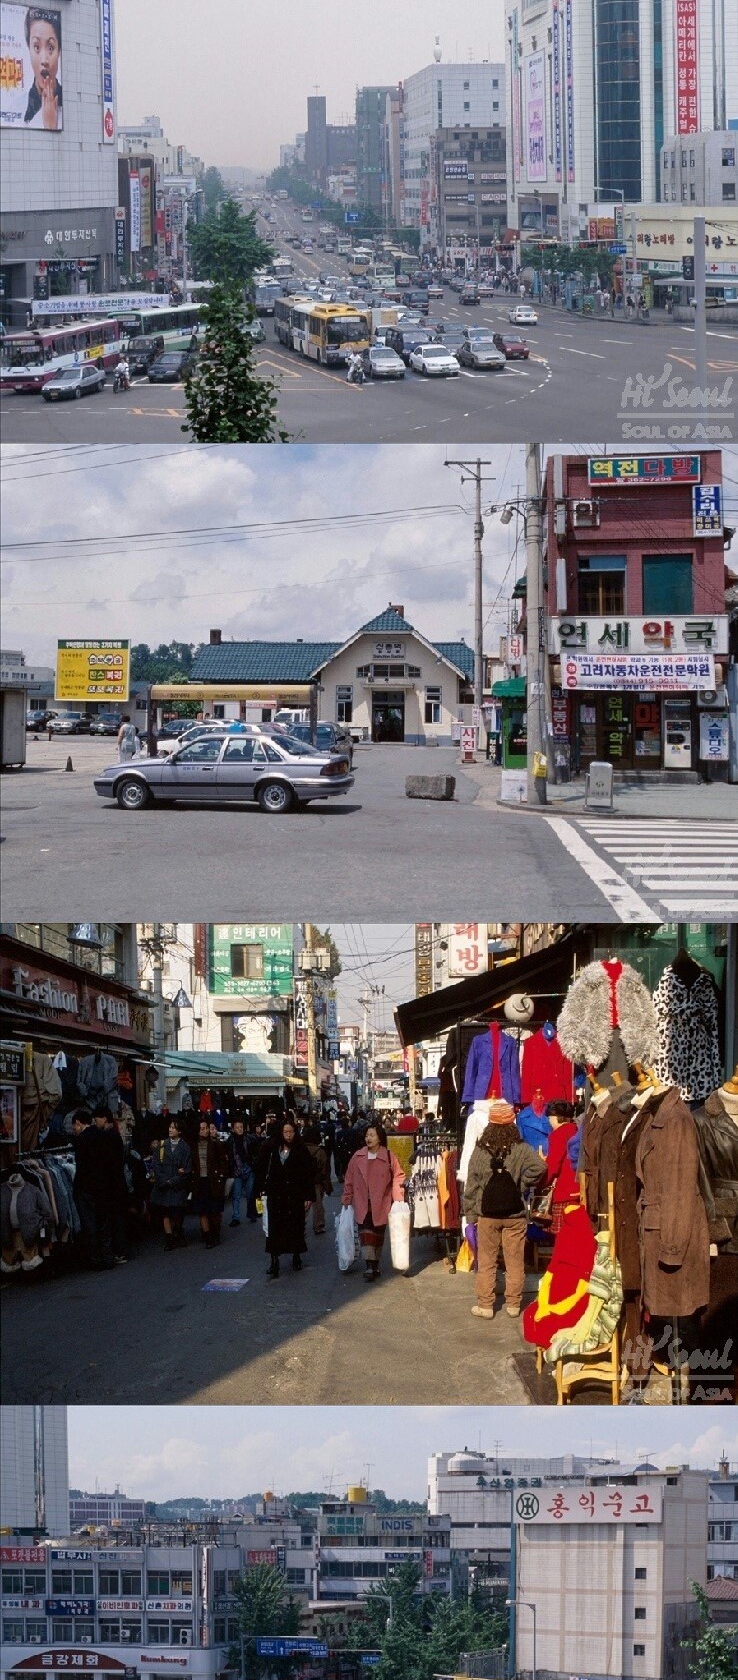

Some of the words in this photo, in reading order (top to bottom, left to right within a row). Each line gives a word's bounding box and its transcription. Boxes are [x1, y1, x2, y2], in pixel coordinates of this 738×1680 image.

[592, 459, 695, 475] 역전다방
[557, 620, 718, 649] 연세약국
[580, 664, 711, 678] 고려자동차운전전문학원
[461, 729, 476, 752] 사진
[381, 1519, 413, 1531] INDIS
[41, 1653, 100, 1667] 금강제화
